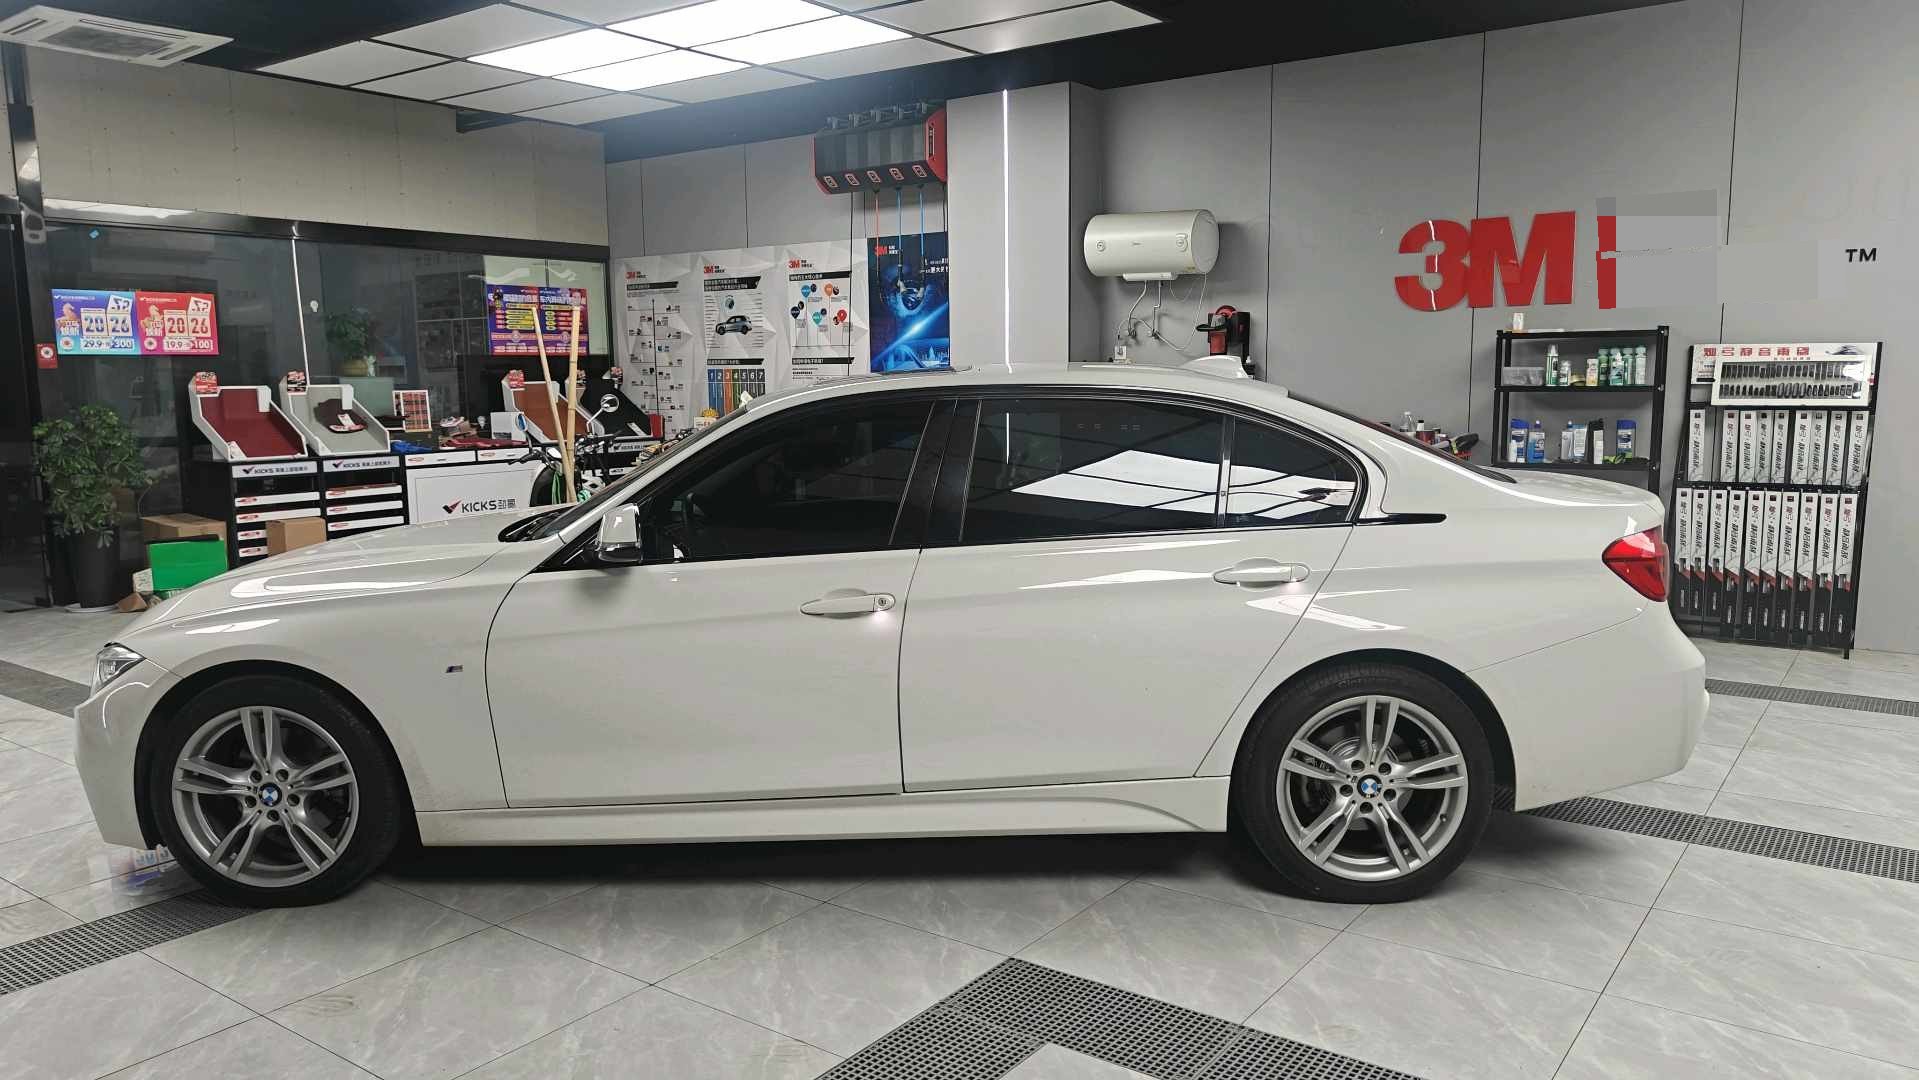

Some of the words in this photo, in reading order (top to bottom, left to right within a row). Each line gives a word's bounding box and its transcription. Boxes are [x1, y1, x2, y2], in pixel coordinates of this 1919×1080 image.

[1395, 211, 1576, 312] 3M
[1845, 247, 1877, 263] TM
[788, 259, 800, 269] 3M
[84, 315, 104, 333] 20
[110, 316, 130, 333] 26
[167, 317, 186, 334] 20
[190, 318, 209, 334] 26
[461, 500, 497, 513] KICKS
